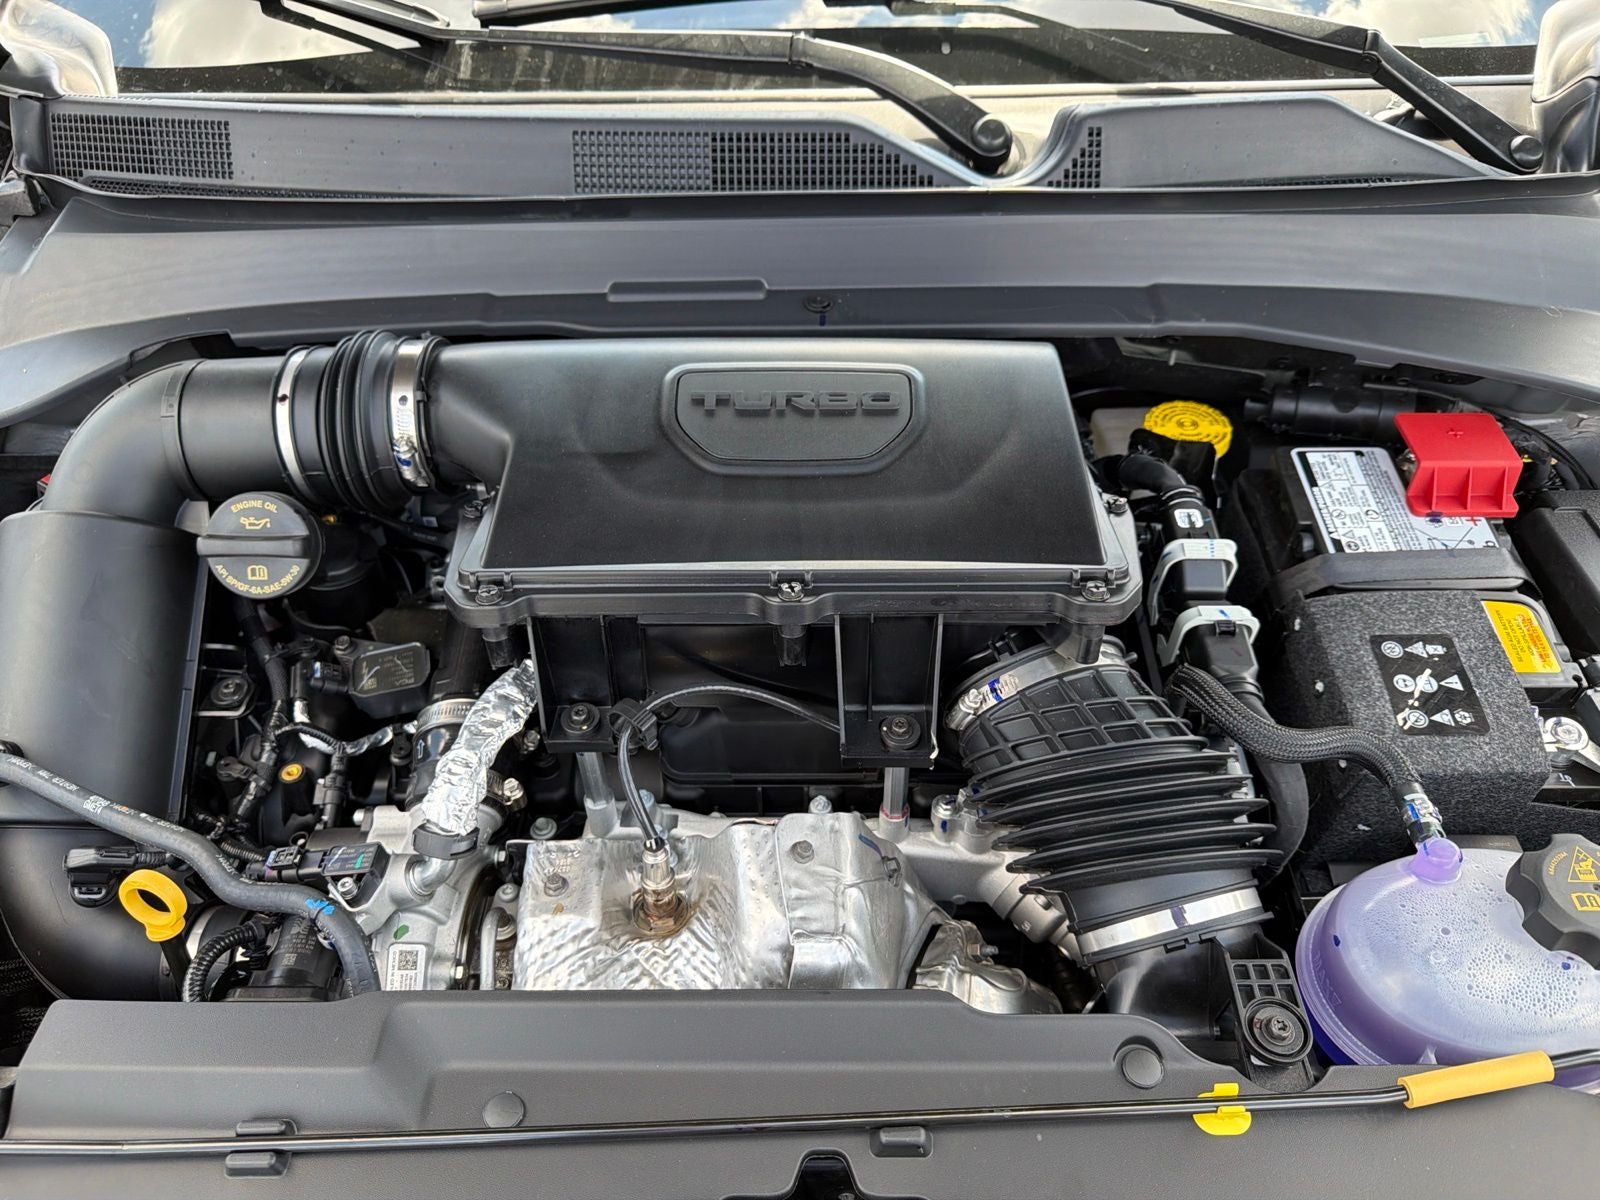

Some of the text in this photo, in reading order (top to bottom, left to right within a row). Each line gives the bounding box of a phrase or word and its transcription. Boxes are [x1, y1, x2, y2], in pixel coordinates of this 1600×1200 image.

[691, 391, 900, 413] TURBO
[231, 500, 278, 513] ENGINE OIL
[215, 564, 229, 578] API
